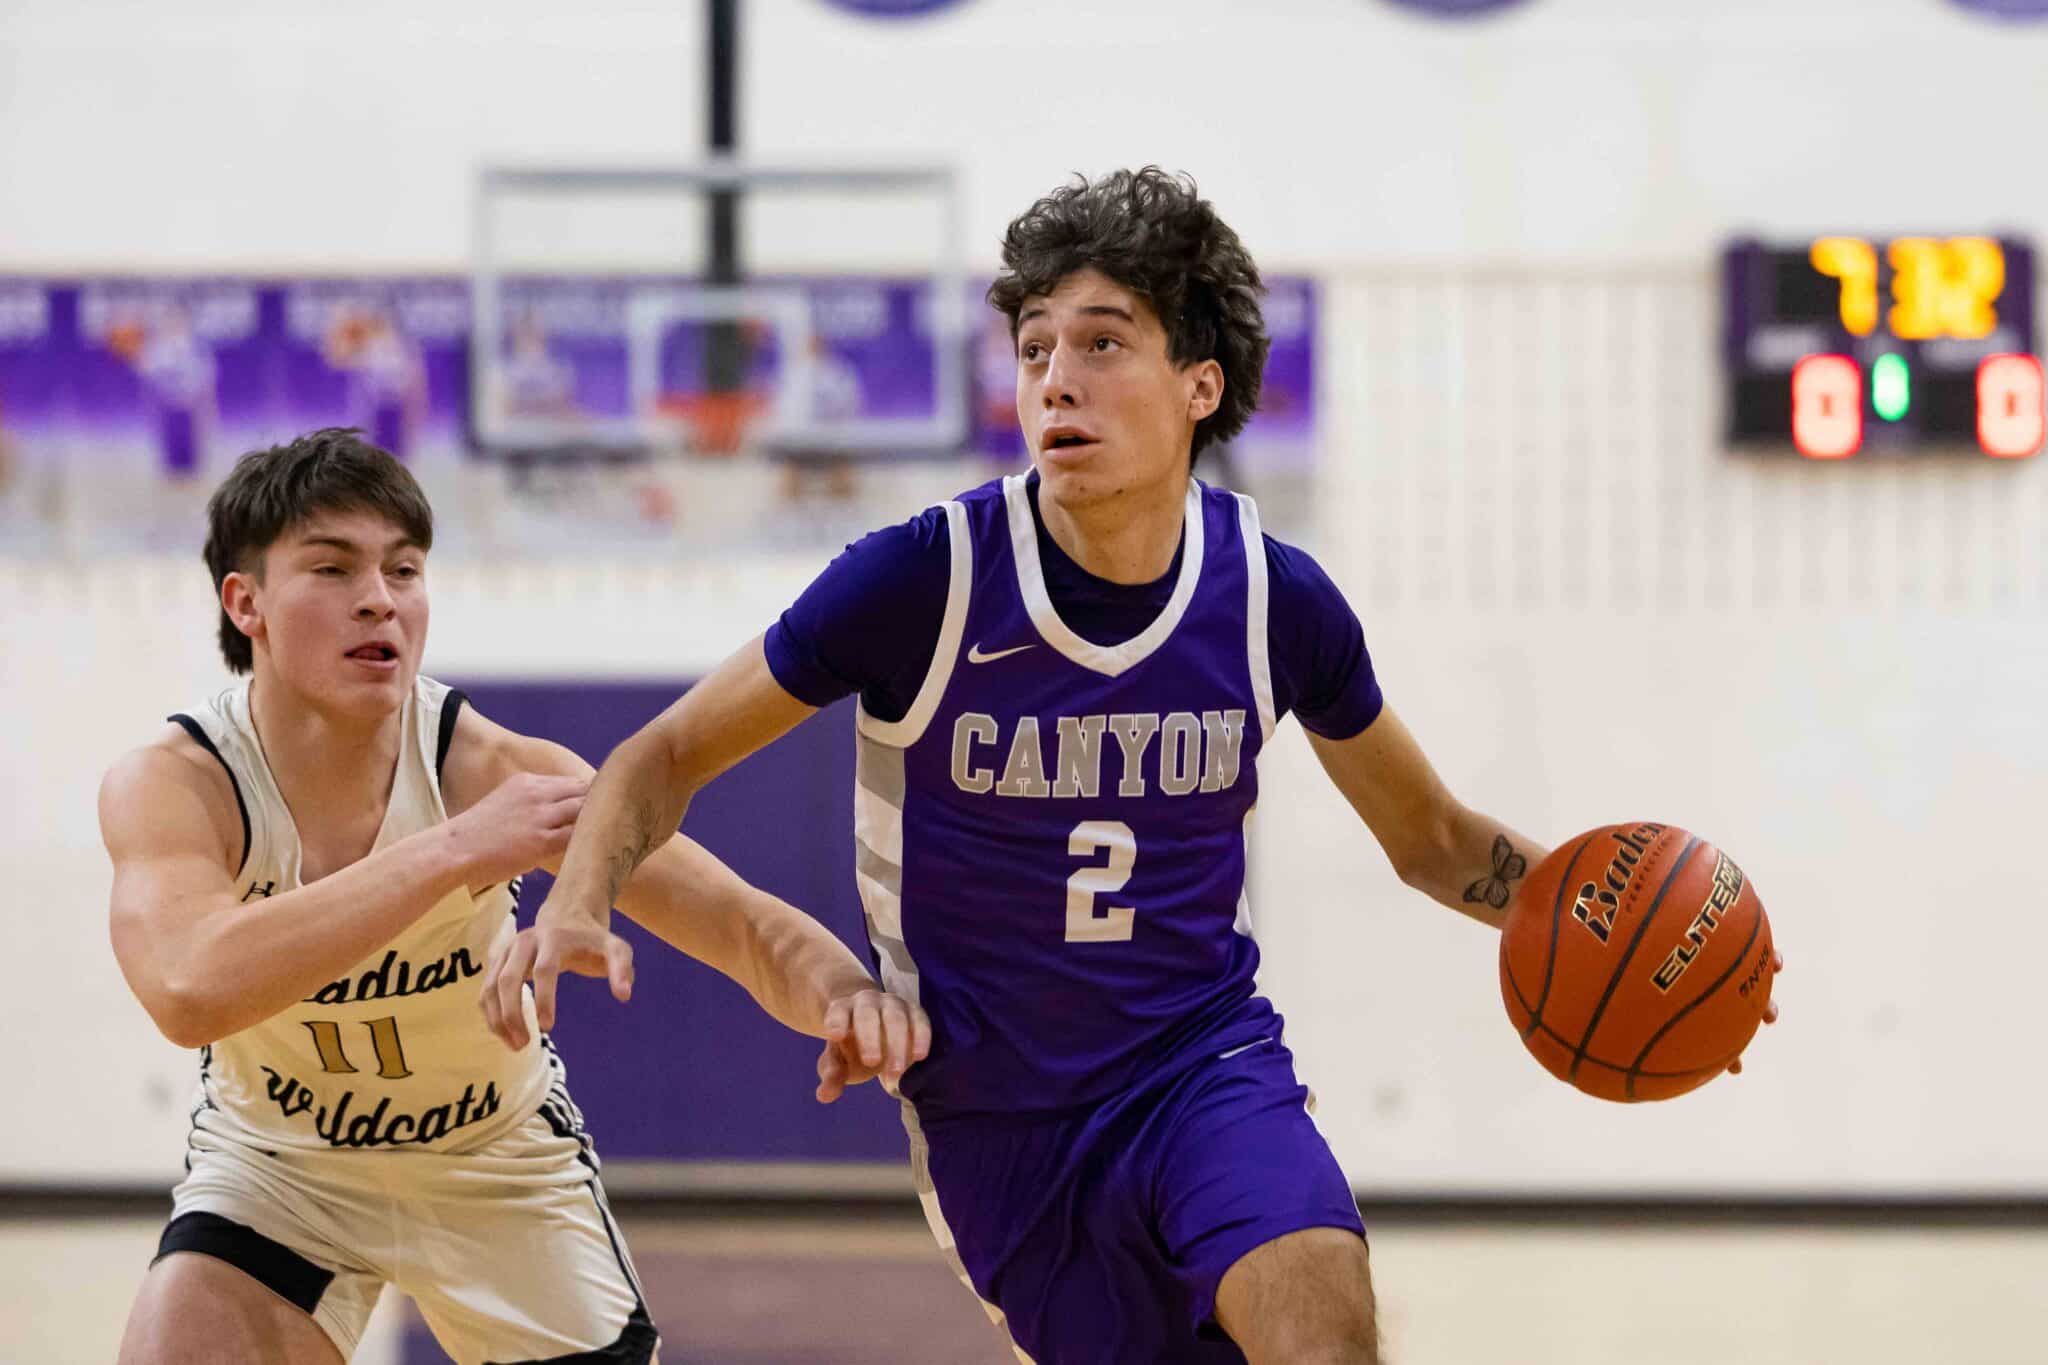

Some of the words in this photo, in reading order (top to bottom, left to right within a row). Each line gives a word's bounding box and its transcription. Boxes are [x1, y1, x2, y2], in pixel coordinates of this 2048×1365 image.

[1792, 353, 1864, 459] 0
[1976, 353, 2046, 459] 0
[950, 709, 1247, 798] CANYON
[1064, 820, 1137, 943] 2
[1572, 823, 1667, 945] Baden
[302, 946, 482, 1004] adian
[301, 1016, 413, 1079] 11
[260, 1065, 502, 1148] Wildcats
